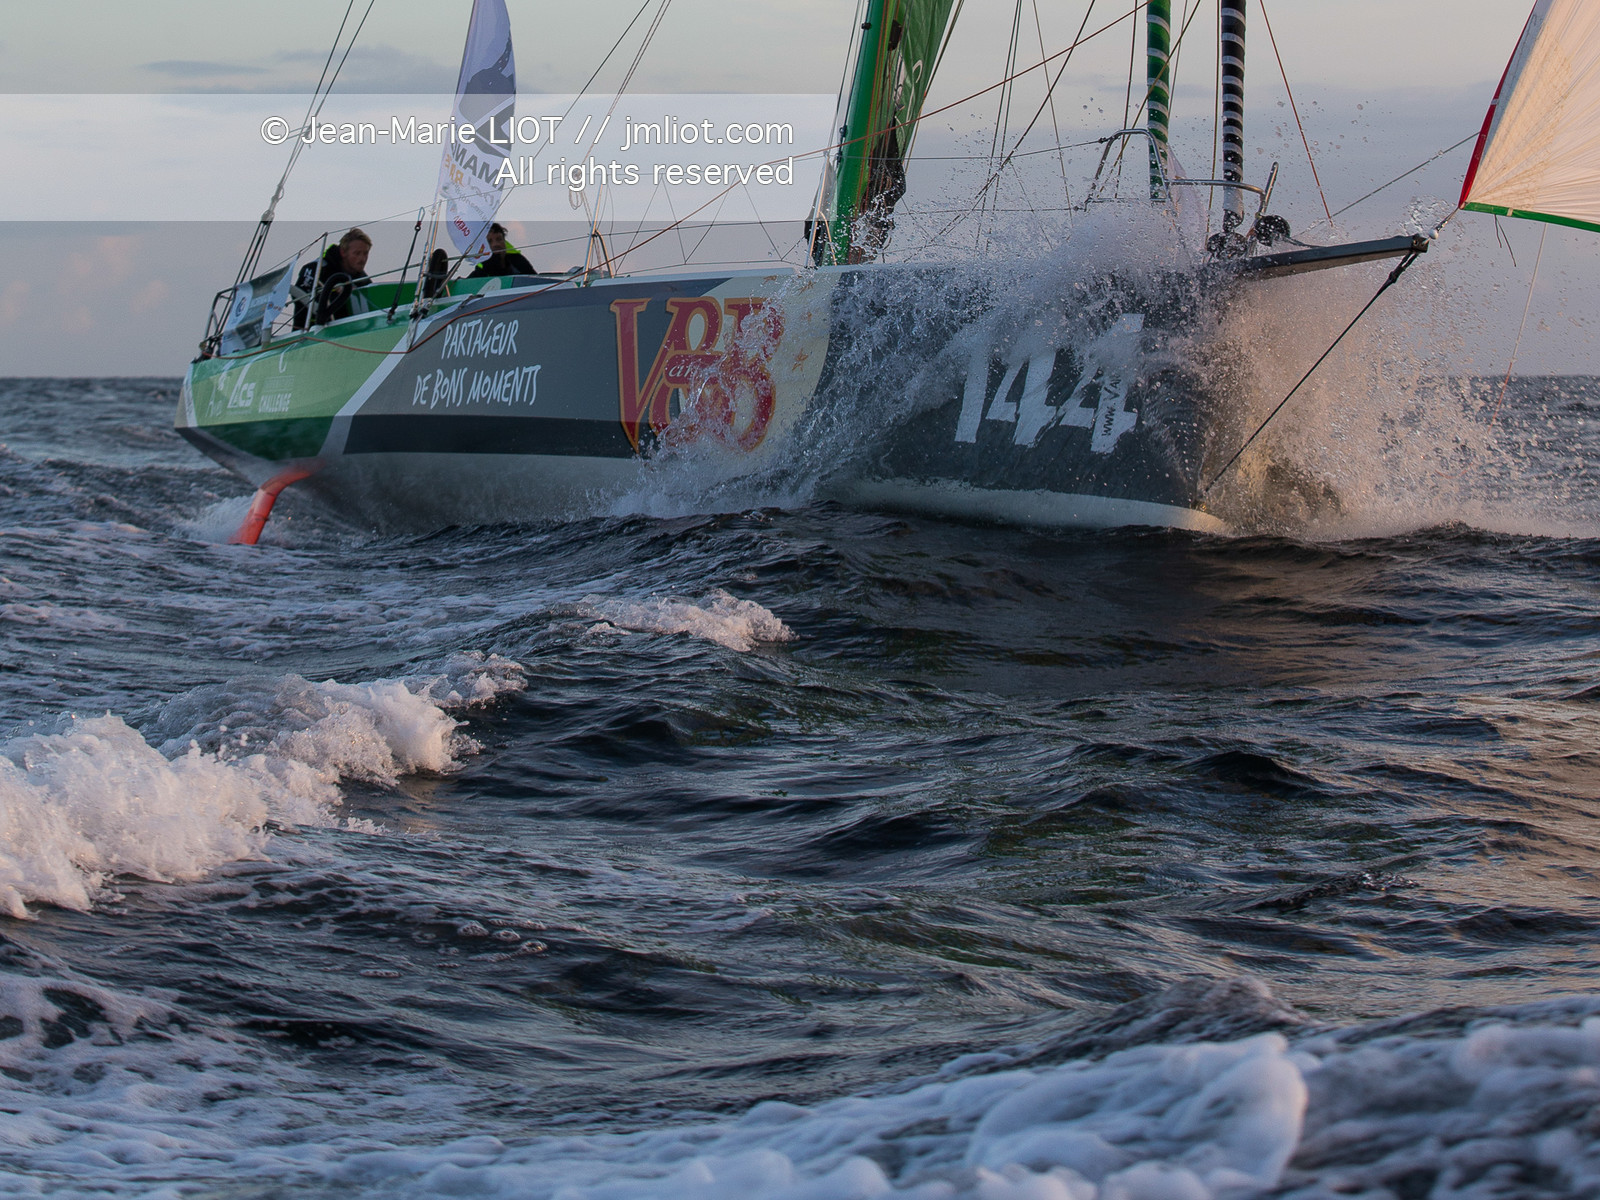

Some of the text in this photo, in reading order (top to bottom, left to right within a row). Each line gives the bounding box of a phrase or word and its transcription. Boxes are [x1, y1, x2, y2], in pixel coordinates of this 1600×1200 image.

[441, 318, 519, 359] PARTAGEUR
[412, 364, 541, 409] DE BONS MOMENTS
[953, 313, 1146, 454] 144
